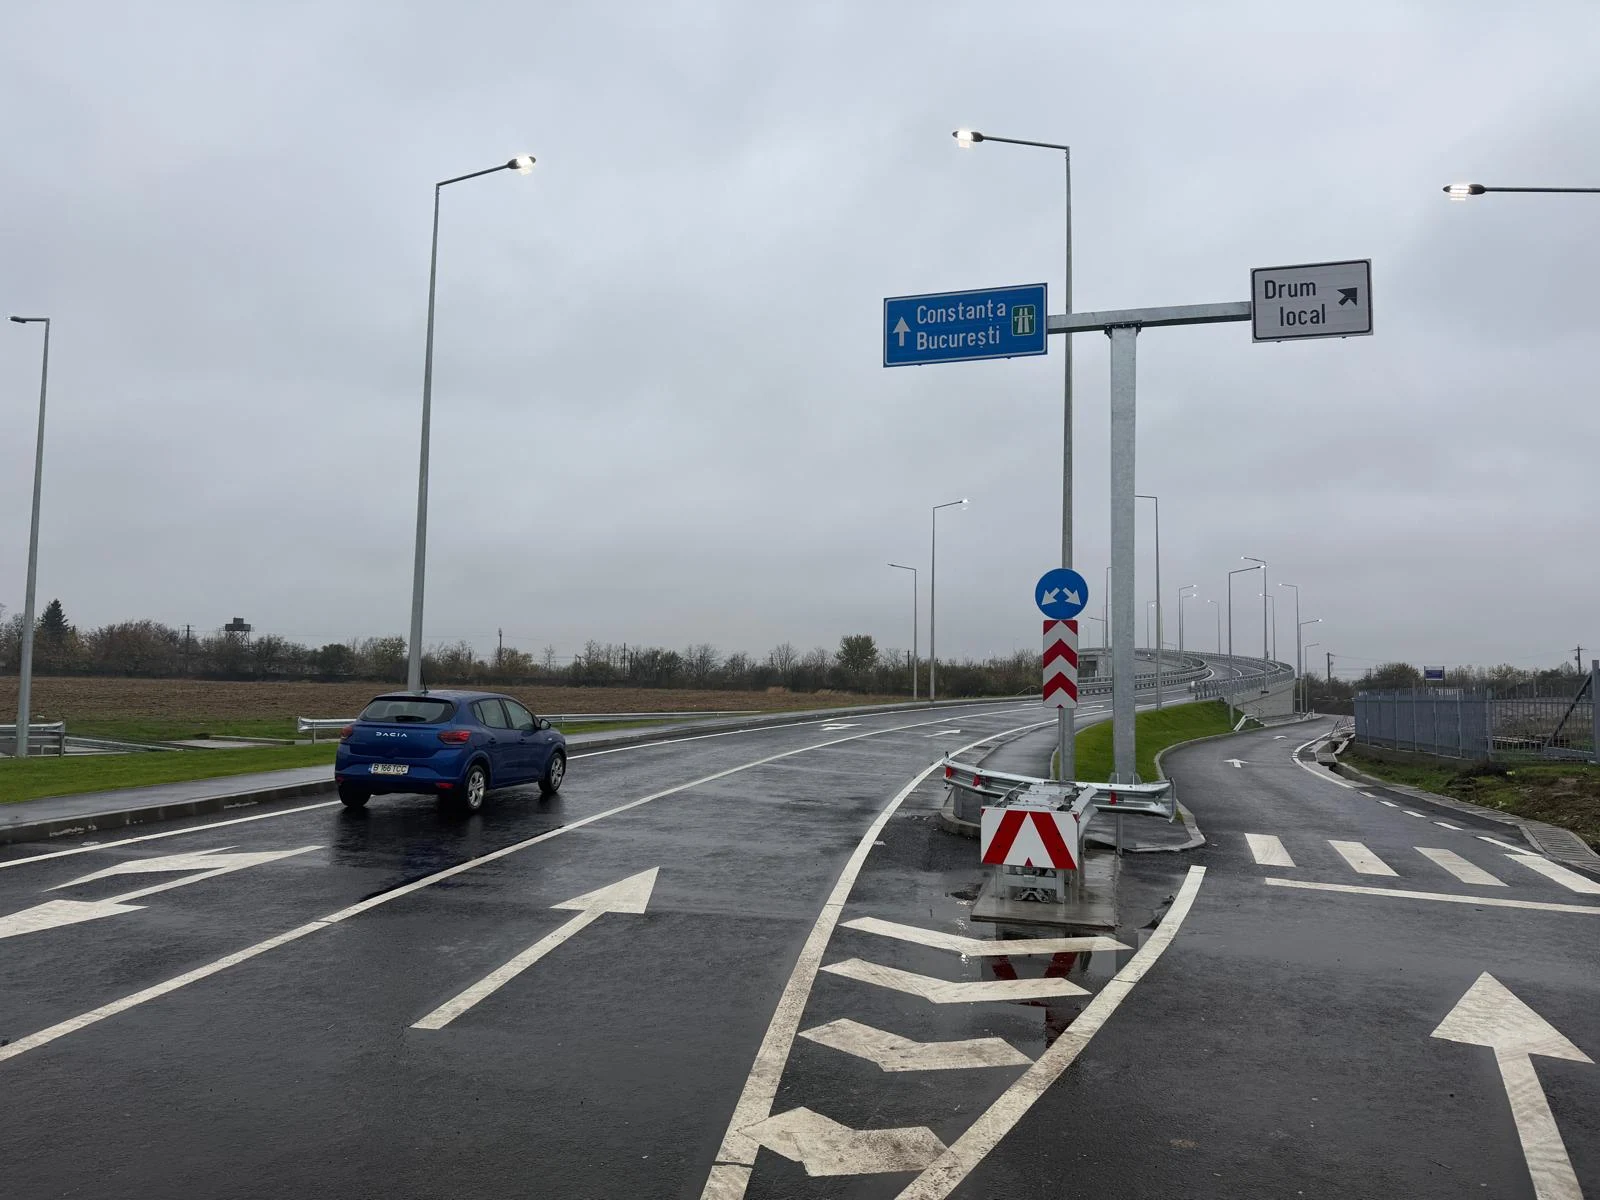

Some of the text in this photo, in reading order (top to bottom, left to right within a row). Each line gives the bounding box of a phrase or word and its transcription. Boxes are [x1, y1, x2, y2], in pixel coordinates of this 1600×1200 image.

[1264, 280, 1316, 299] Drum
[917, 299, 1006, 324] Constanța
[1280, 303, 1326, 327] local
[917, 325, 1000, 350] București
[373, 763, 379, 771] B
